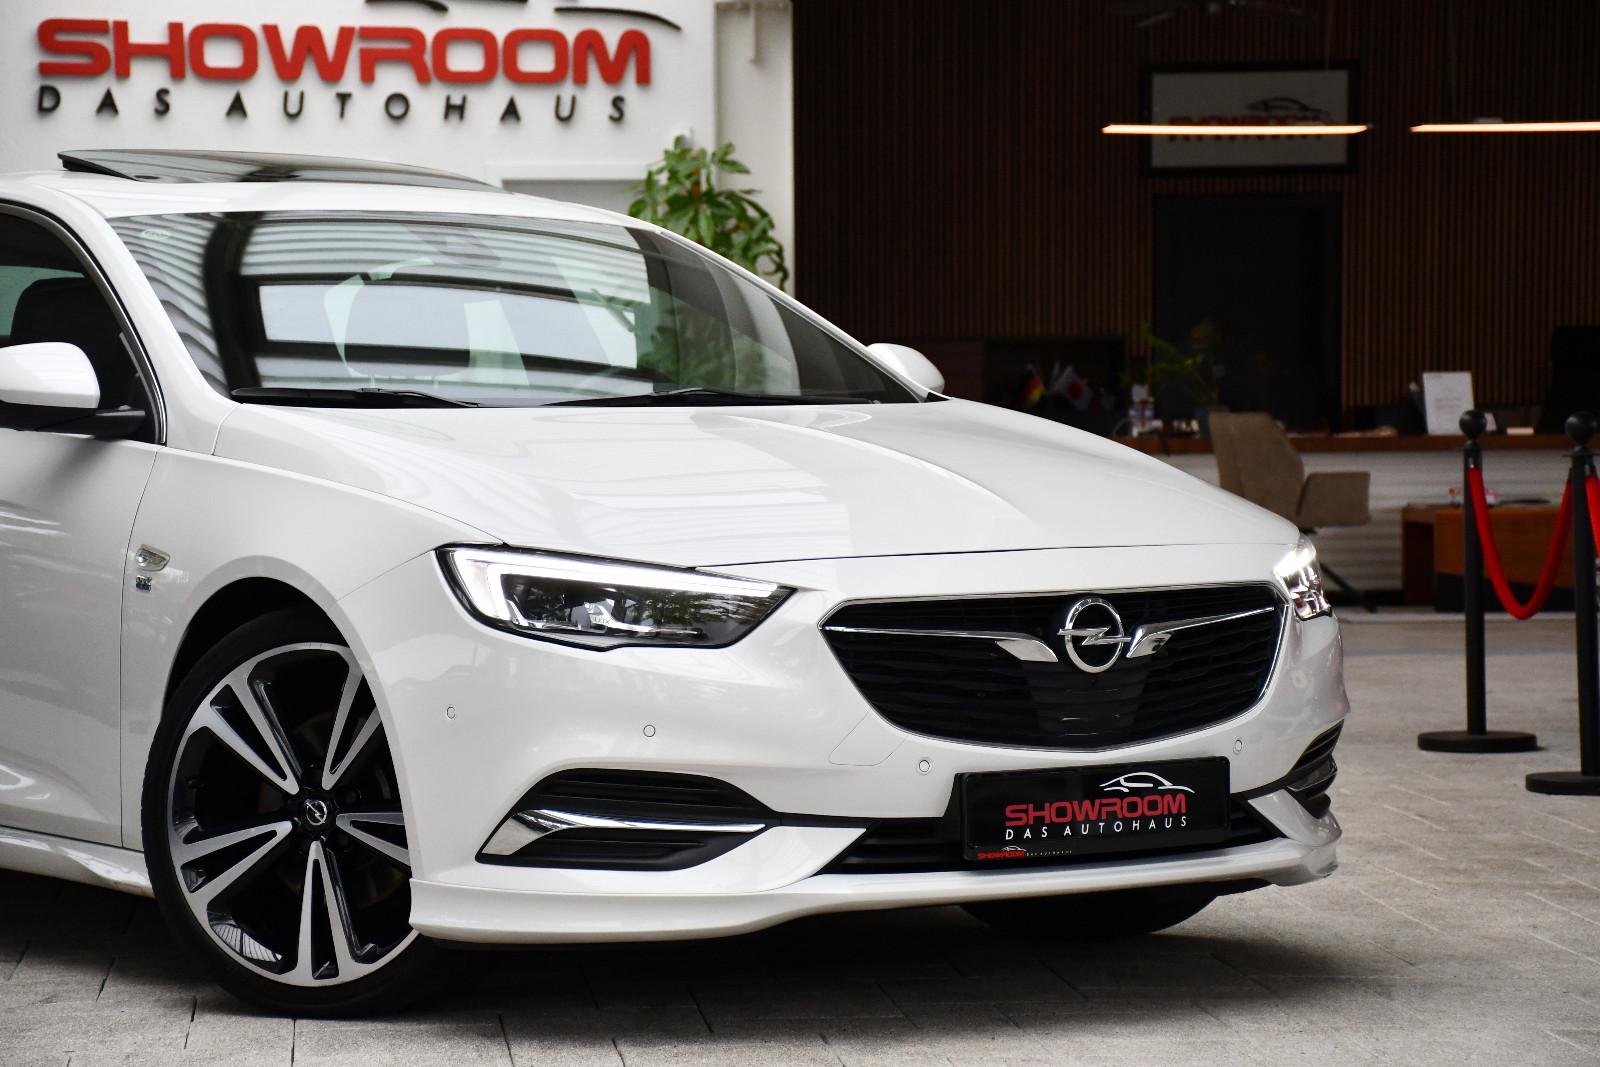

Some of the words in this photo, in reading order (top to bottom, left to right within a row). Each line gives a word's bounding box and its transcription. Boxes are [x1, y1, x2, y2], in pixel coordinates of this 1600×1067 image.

[38, 18, 651, 86] SHOWROOM
[37, 84, 171, 118] DAS
[226, 91, 625, 124] AUTOHAUS
[1005, 793, 1187, 827] SHOWROOM
[1005, 826, 1048, 841] DAS
[1063, 816, 1187, 837] AUTOHAUS
